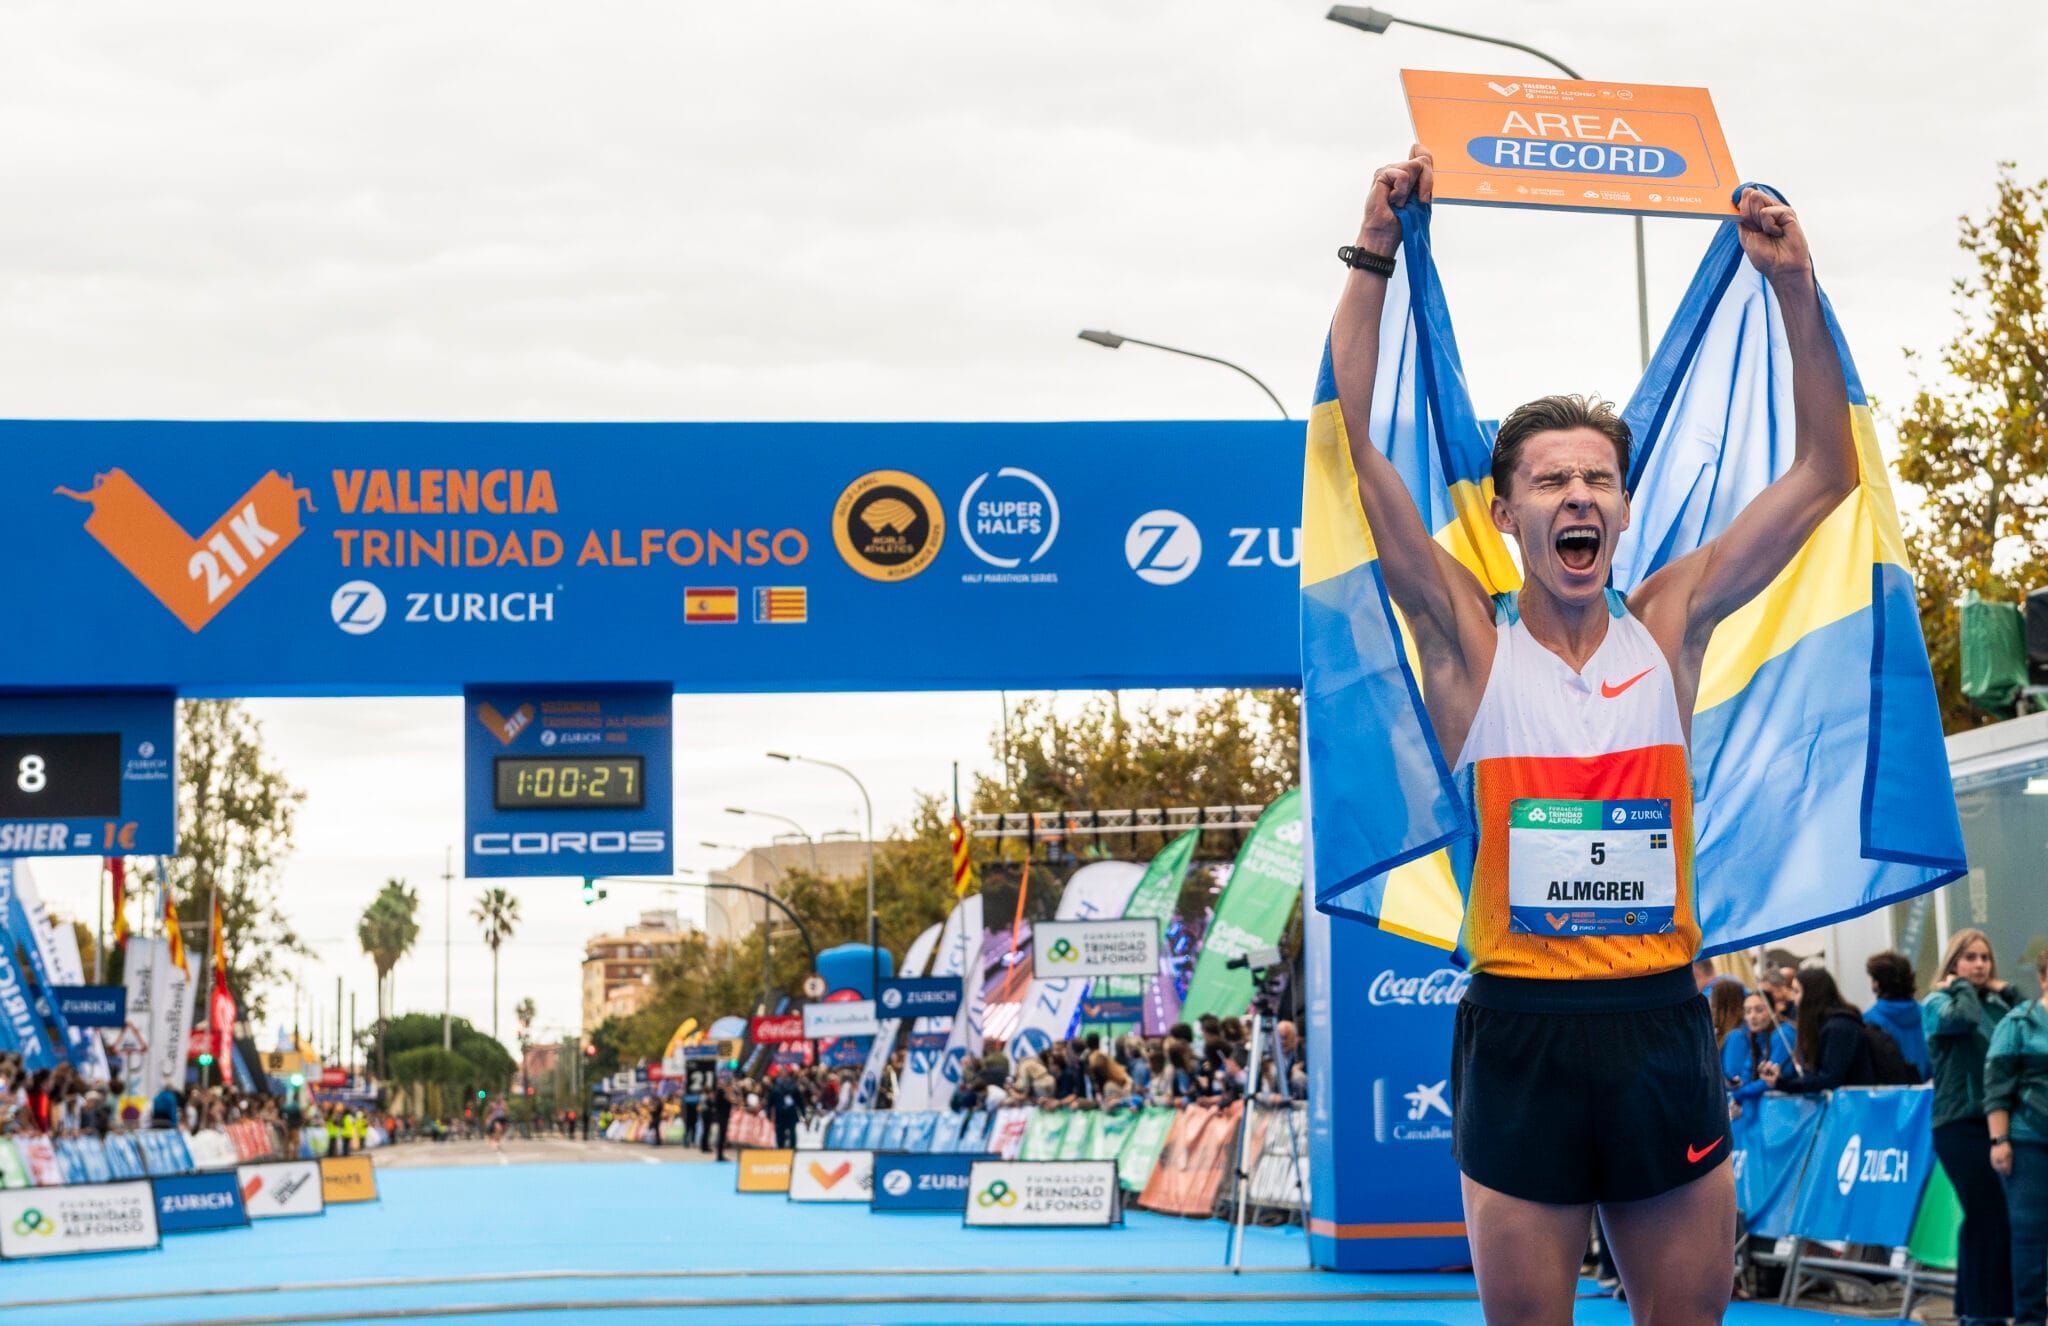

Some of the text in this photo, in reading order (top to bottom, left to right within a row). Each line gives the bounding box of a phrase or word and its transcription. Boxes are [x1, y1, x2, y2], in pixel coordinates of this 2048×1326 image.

[1501, 110, 1643, 143] AREA
[1494, 139, 1665, 174] RECORD
[1666, 195, 1702, 204] ZURICH
[332, 469, 559, 513] VALENCIA
[977, 501, 1042, 518] SUPER
[977, 519, 1042, 535] HALFS
[187, 501, 280, 605] 21K
[333, 528, 809, 567] TRINIDAD ALFONSO
[1227, 527, 1302, 568] ZU
[404, 592, 554, 622] ZURICH
[503, 711, 528, 738] 21K
[17, 754, 47, 793] 8
[517, 766, 634, 797] 1:00:27
[1549, 817, 1583, 825] ALFONSO
[1630, 809, 1663, 820] ZURICH
[103, 822, 139, 849] 1€
[473, 831, 666, 855] COROS
[1590, 842, 1606, 866] 5
[1547, 881, 1645, 901] ALMGREN
[1084, 940, 1147, 953] TRINIDAD
[1085, 952, 1148, 965] ALFONSO
[906, 991, 957, 1004] ZURICH
[161, 1191, 234, 1213] ZURICH
[1025, 1185, 1104, 1198] TRINIDAD
[61, 1207, 142, 1224] TRINIDAD
[1023, 1199, 1102, 1212] ALFONSO
[63, 1219, 145, 1237] ALFONSO
